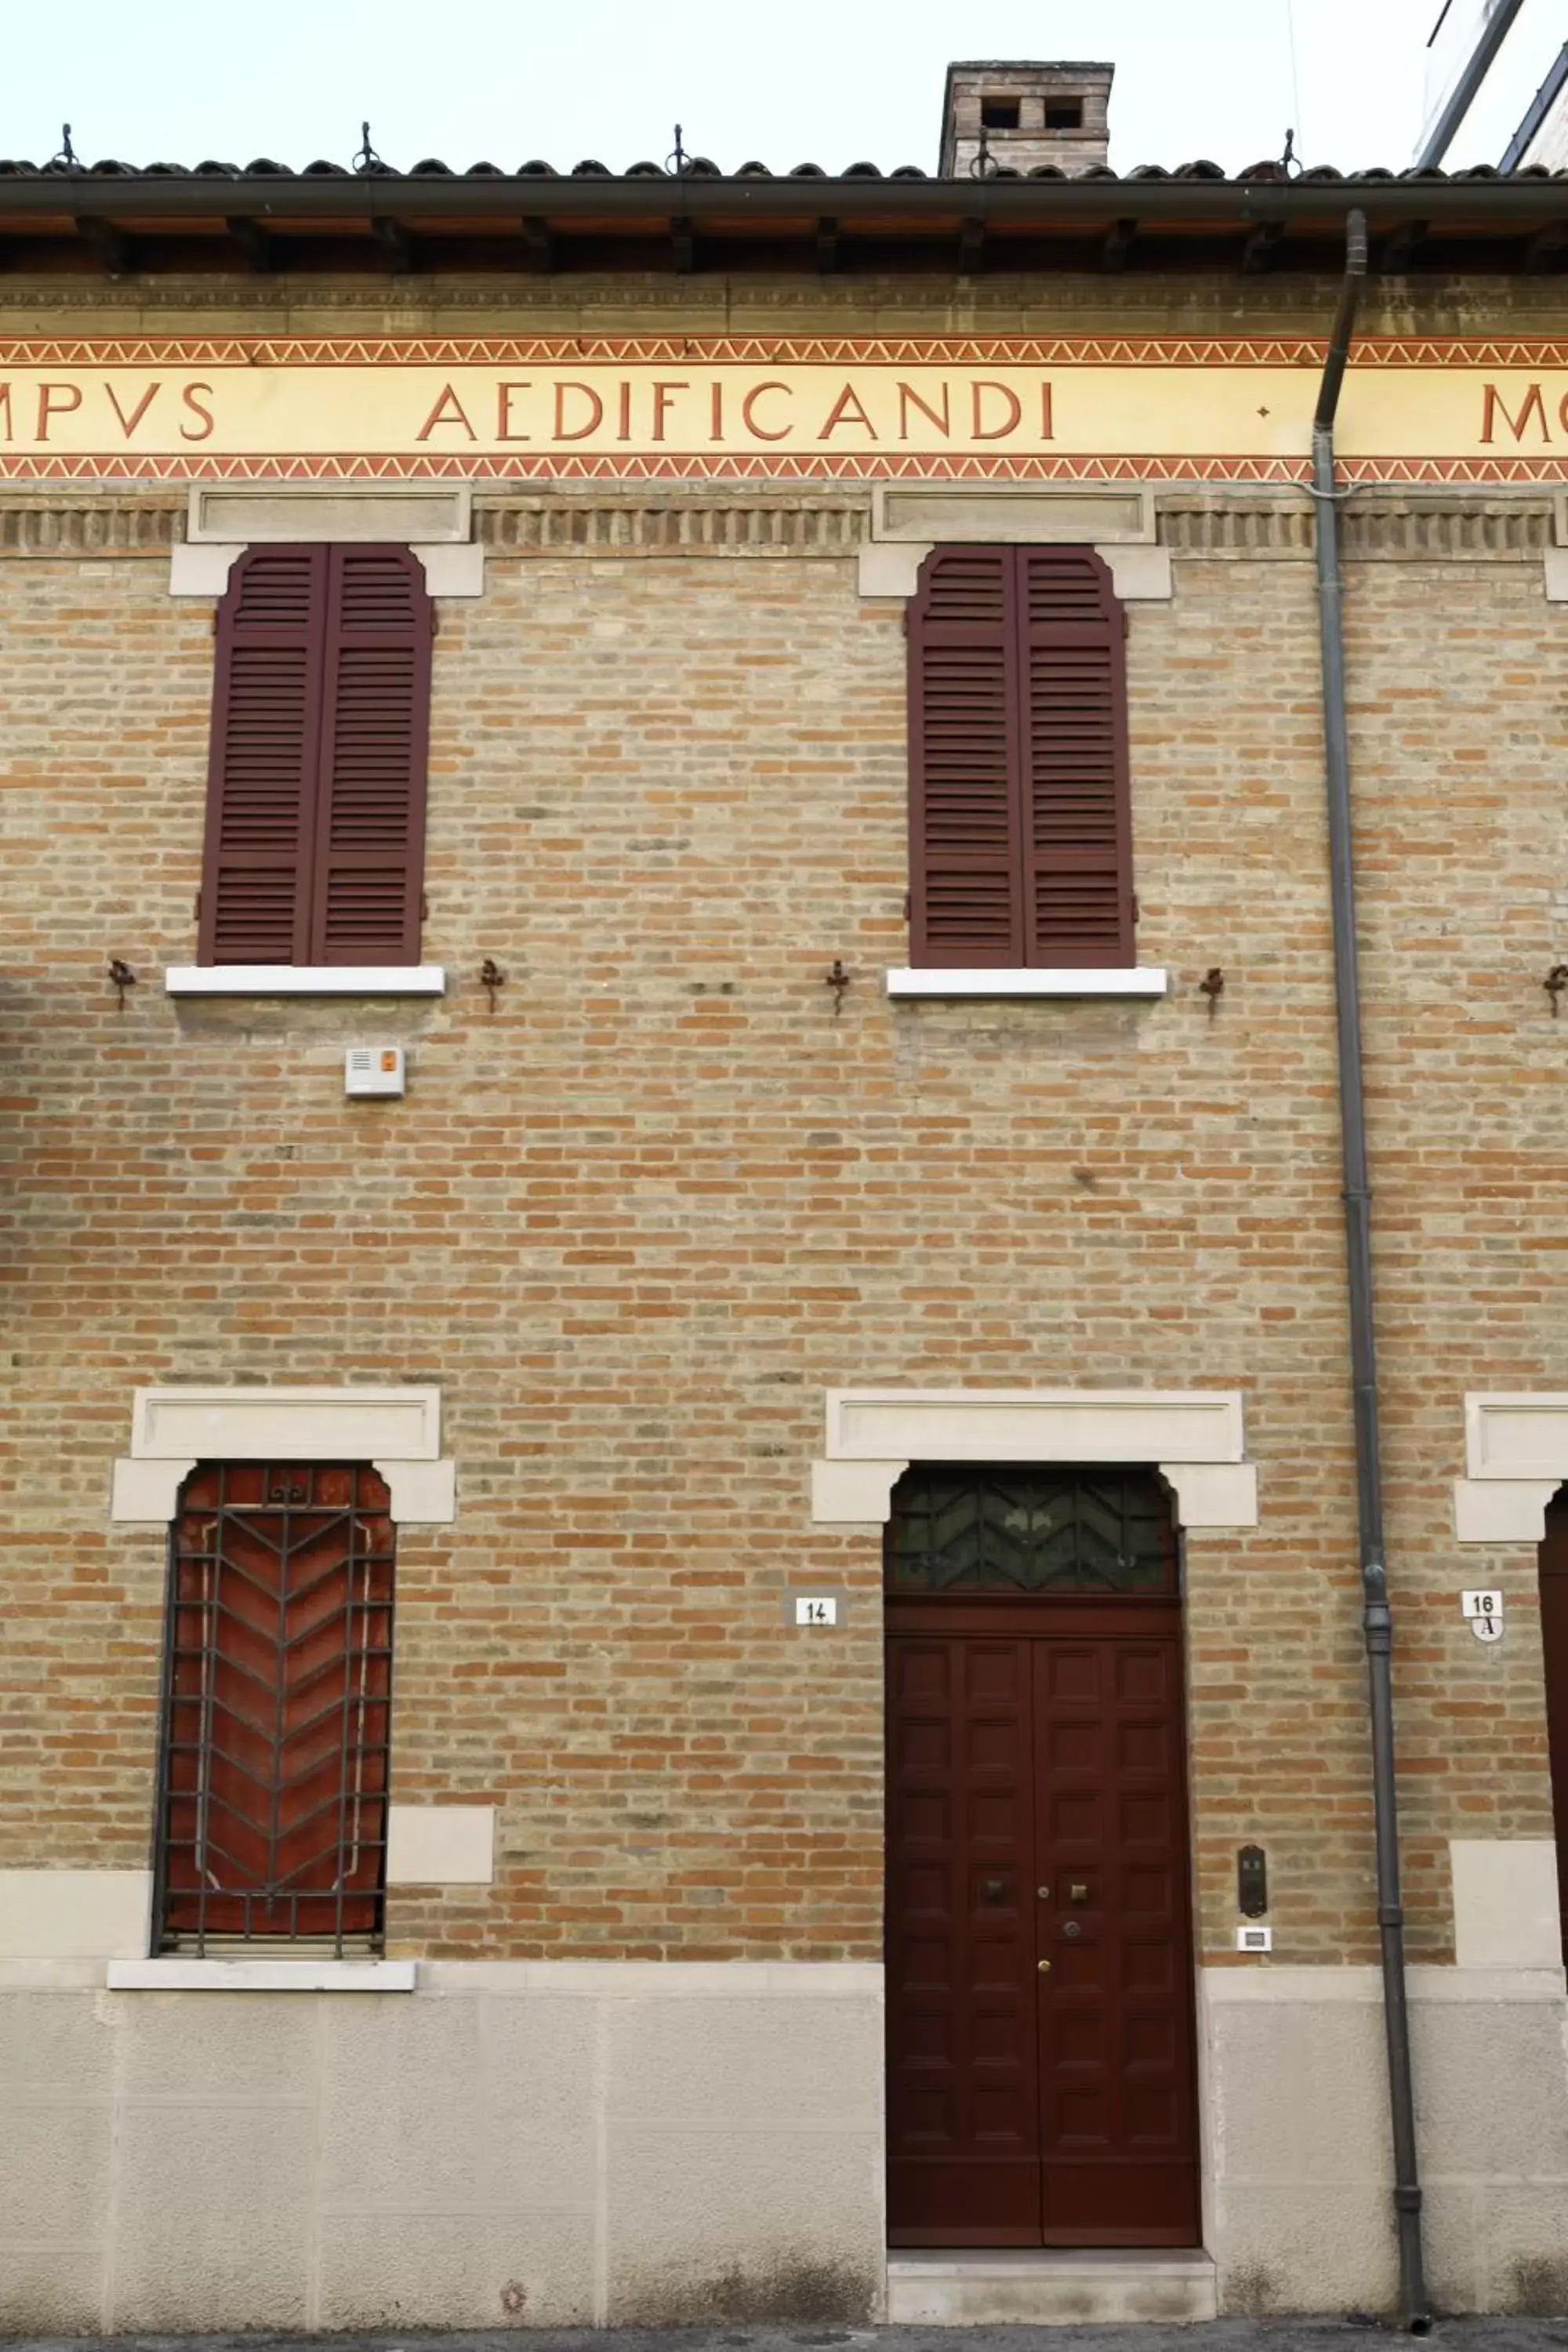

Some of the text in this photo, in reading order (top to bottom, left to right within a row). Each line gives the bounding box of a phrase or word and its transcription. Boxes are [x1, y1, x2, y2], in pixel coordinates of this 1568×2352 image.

[0, 381, 1568, 444] PVS AEDIFICANDI M
[807, 1602, 826, 1619] 14
[1474, 1595, 1494, 1613] 16
